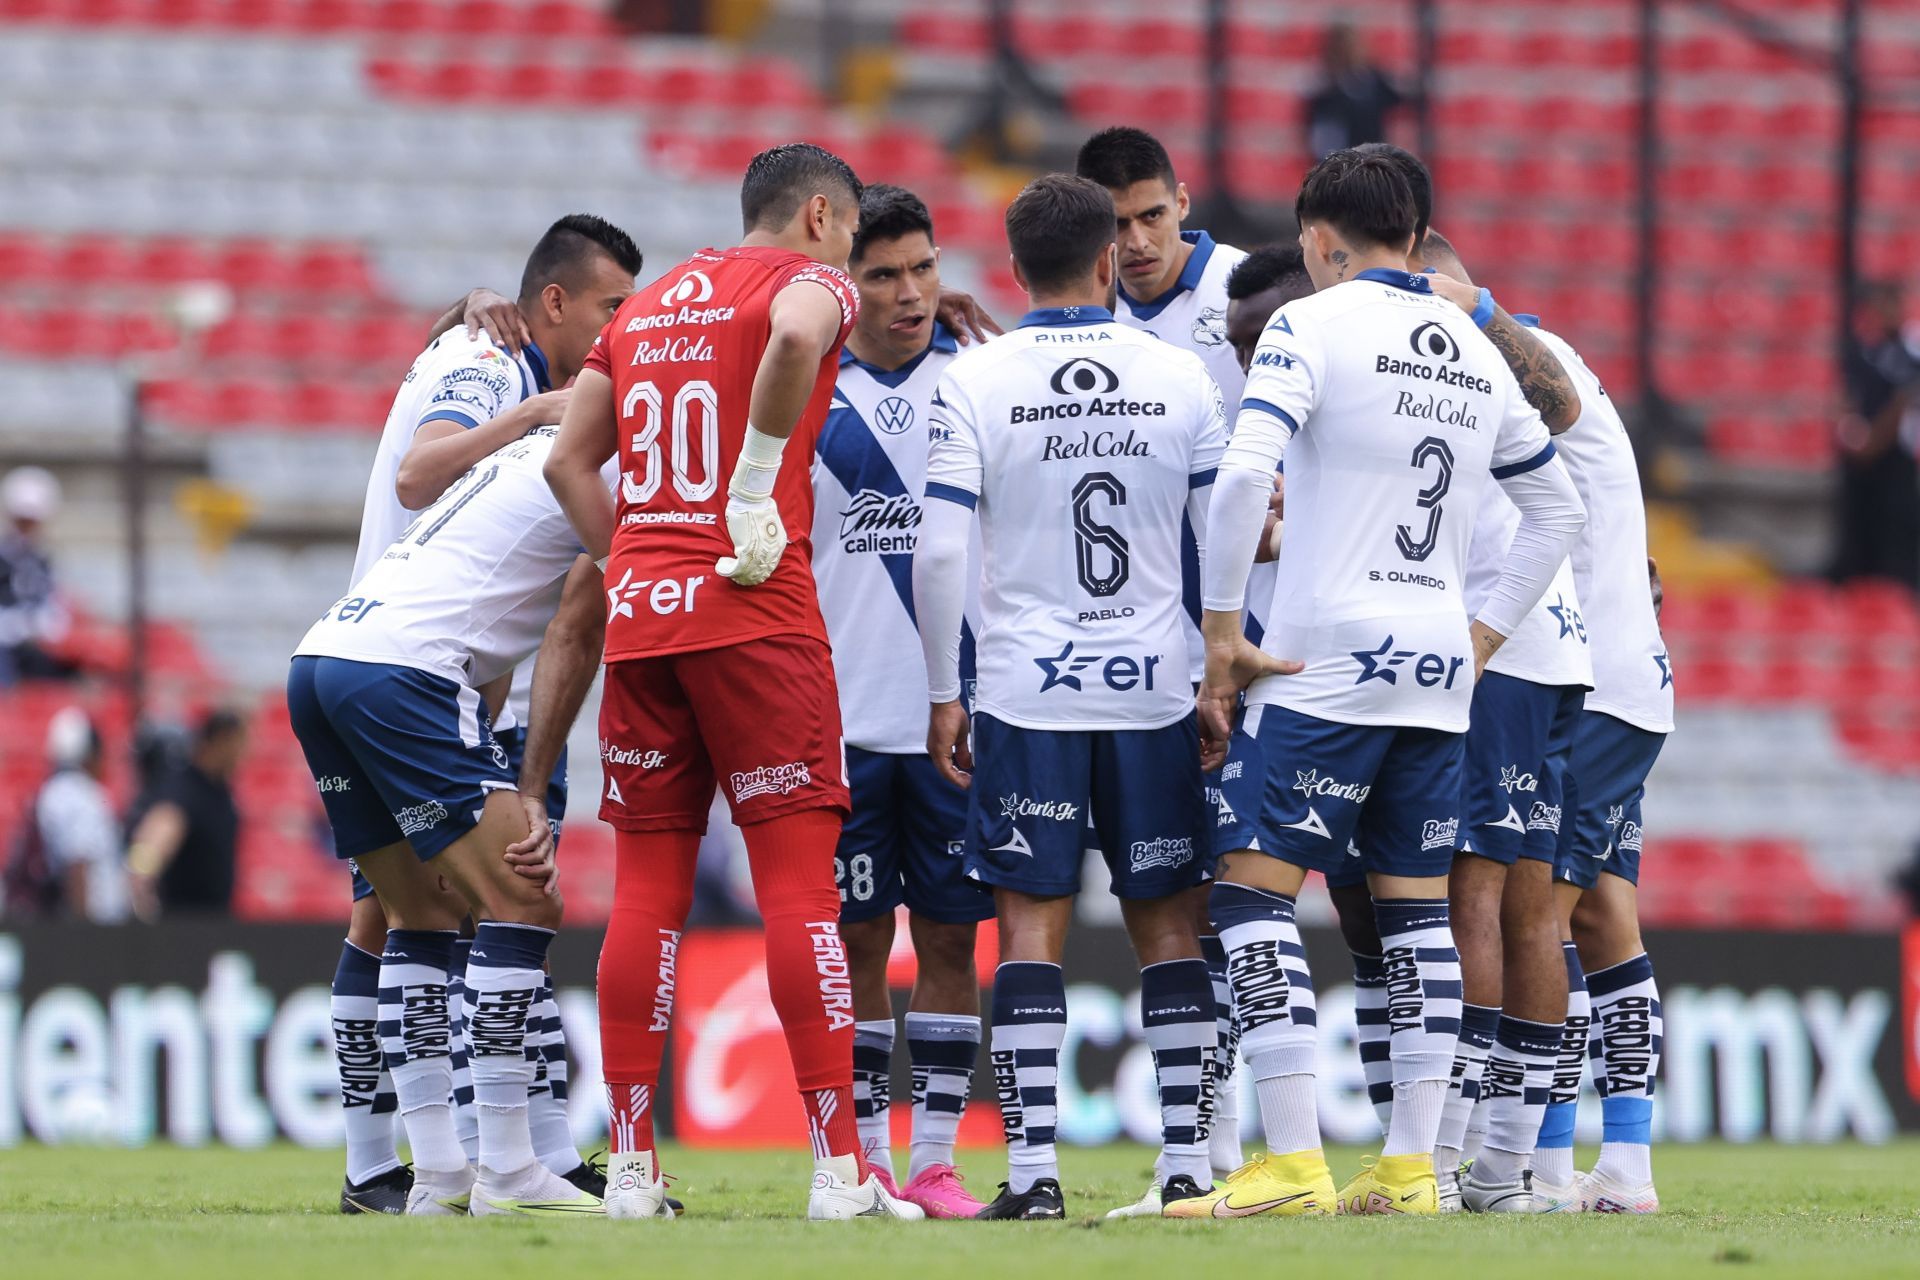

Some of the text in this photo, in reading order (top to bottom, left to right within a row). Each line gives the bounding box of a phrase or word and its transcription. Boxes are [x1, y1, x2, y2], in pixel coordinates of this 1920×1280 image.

[624, 305, 735, 333] Banco Azteca
[1035, 331, 1112, 343] PIRMA
[1010, 398, 1166, 424] Banco Azteca
[1375, 355, 1492, 395] Banco Azteca
[622, 381, 718, 503] 30
[1071, 472, 1129, 597] 6
[1395, 436, 1455, 562] 3
[337, 597, 385, 624] er
[649, 576, 704, 615] er
[1077, 607, 1136, 622] PABLO
[1369, 570, 1447, 591] S. OLMEDO
[1103, 655, 1159, 692] er
[1415, 653, 1464, 690] er
[648, 928, 682, 1032] PERDURA
[805, 921, 855, 1032] PERDURA
[1012, 1007, 1065, 1016] PIRMA
[1148, 1005, 1201, 1017] PIRMA
[1229, 940, 1290, 1033] PERDURA
[1384, 947, 1424, 1035] PERDURA
[403, 983, 452, 1059] PERDURA
[471, 988, 536, 1058] PERDURA
[1598, 996, 1652, 1094] PERDURA
[333, 1018, 381, 1108] PERDURA
[1195, 1045, 1218, 1143] PERDURA
[1548, 1016, 1591, 1104] PERDURA
[991, 1050, 1024, 1144] PERDURA
